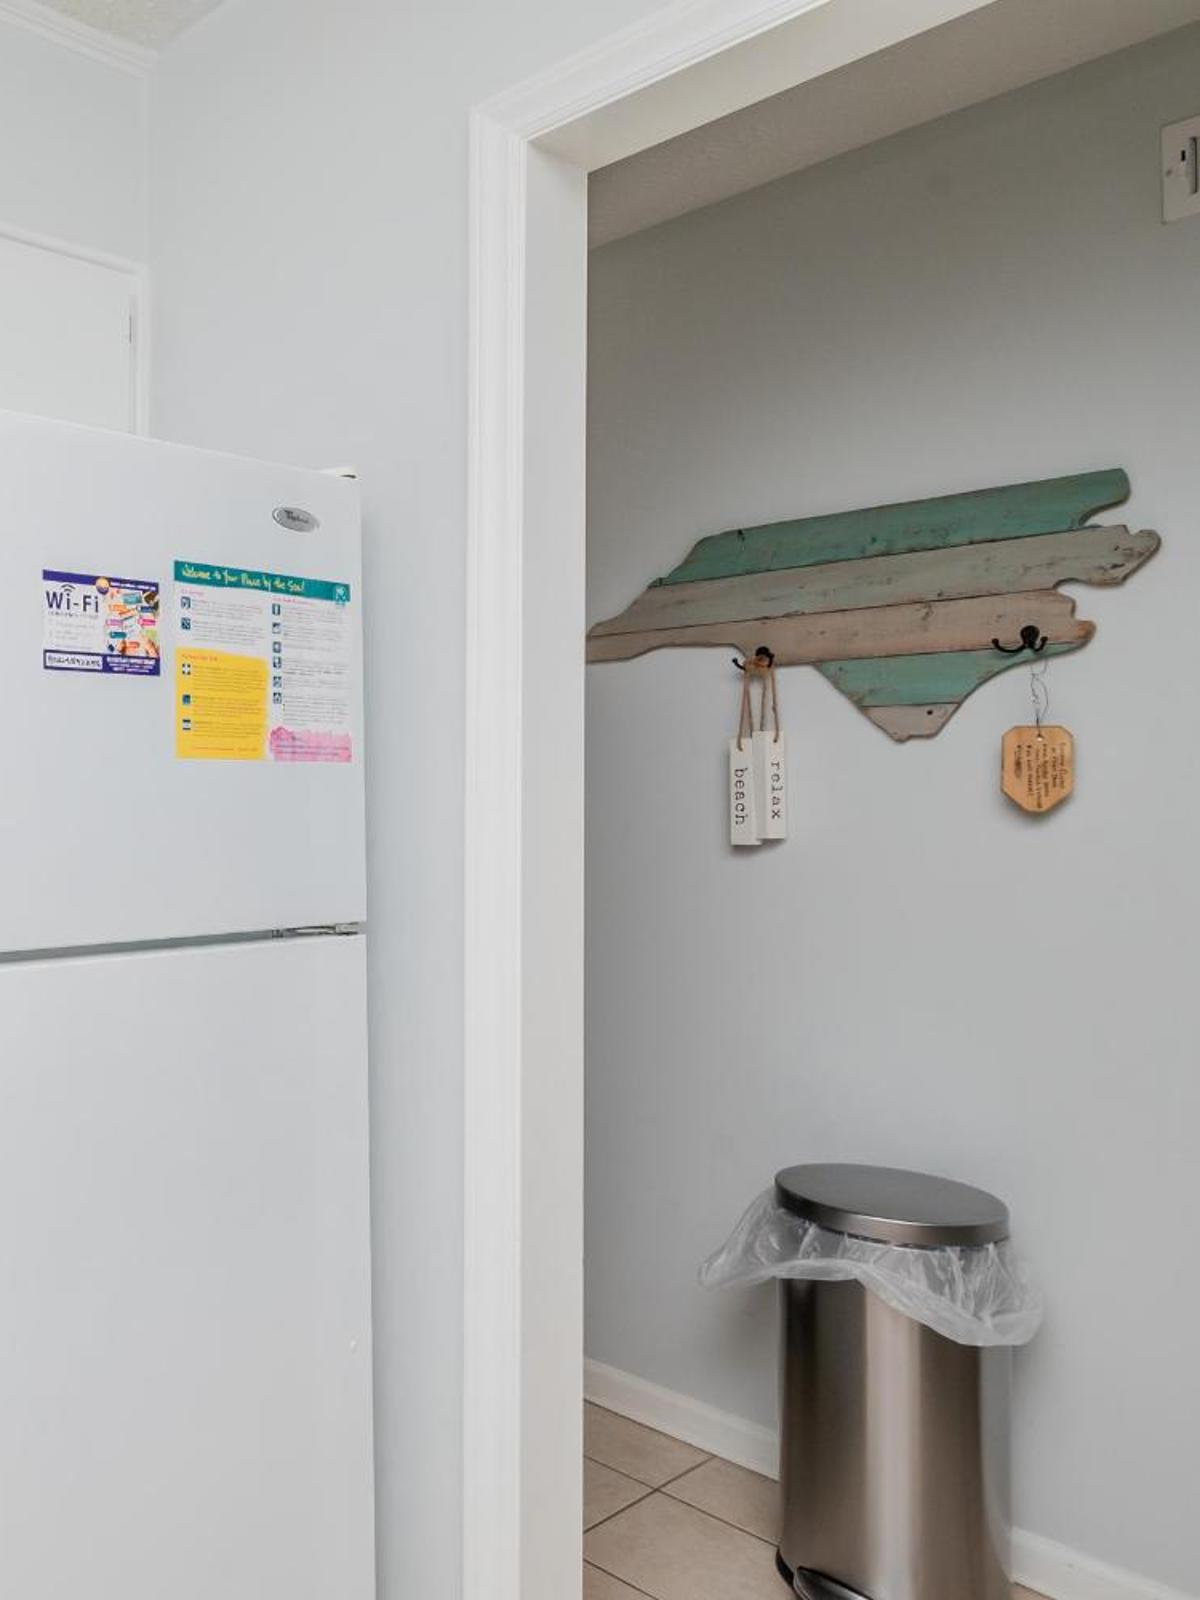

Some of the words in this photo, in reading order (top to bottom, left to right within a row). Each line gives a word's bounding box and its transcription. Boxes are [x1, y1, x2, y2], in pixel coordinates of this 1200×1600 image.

[181, 564, 211, 580] Welcome
[214, 569, 222, 580] to
[262, 575, 272, 592] by
[46, 590, 99, 613] Wi-Fi
[734, 767, 749, 825] beach
[770, 761, 783, 820] relax
